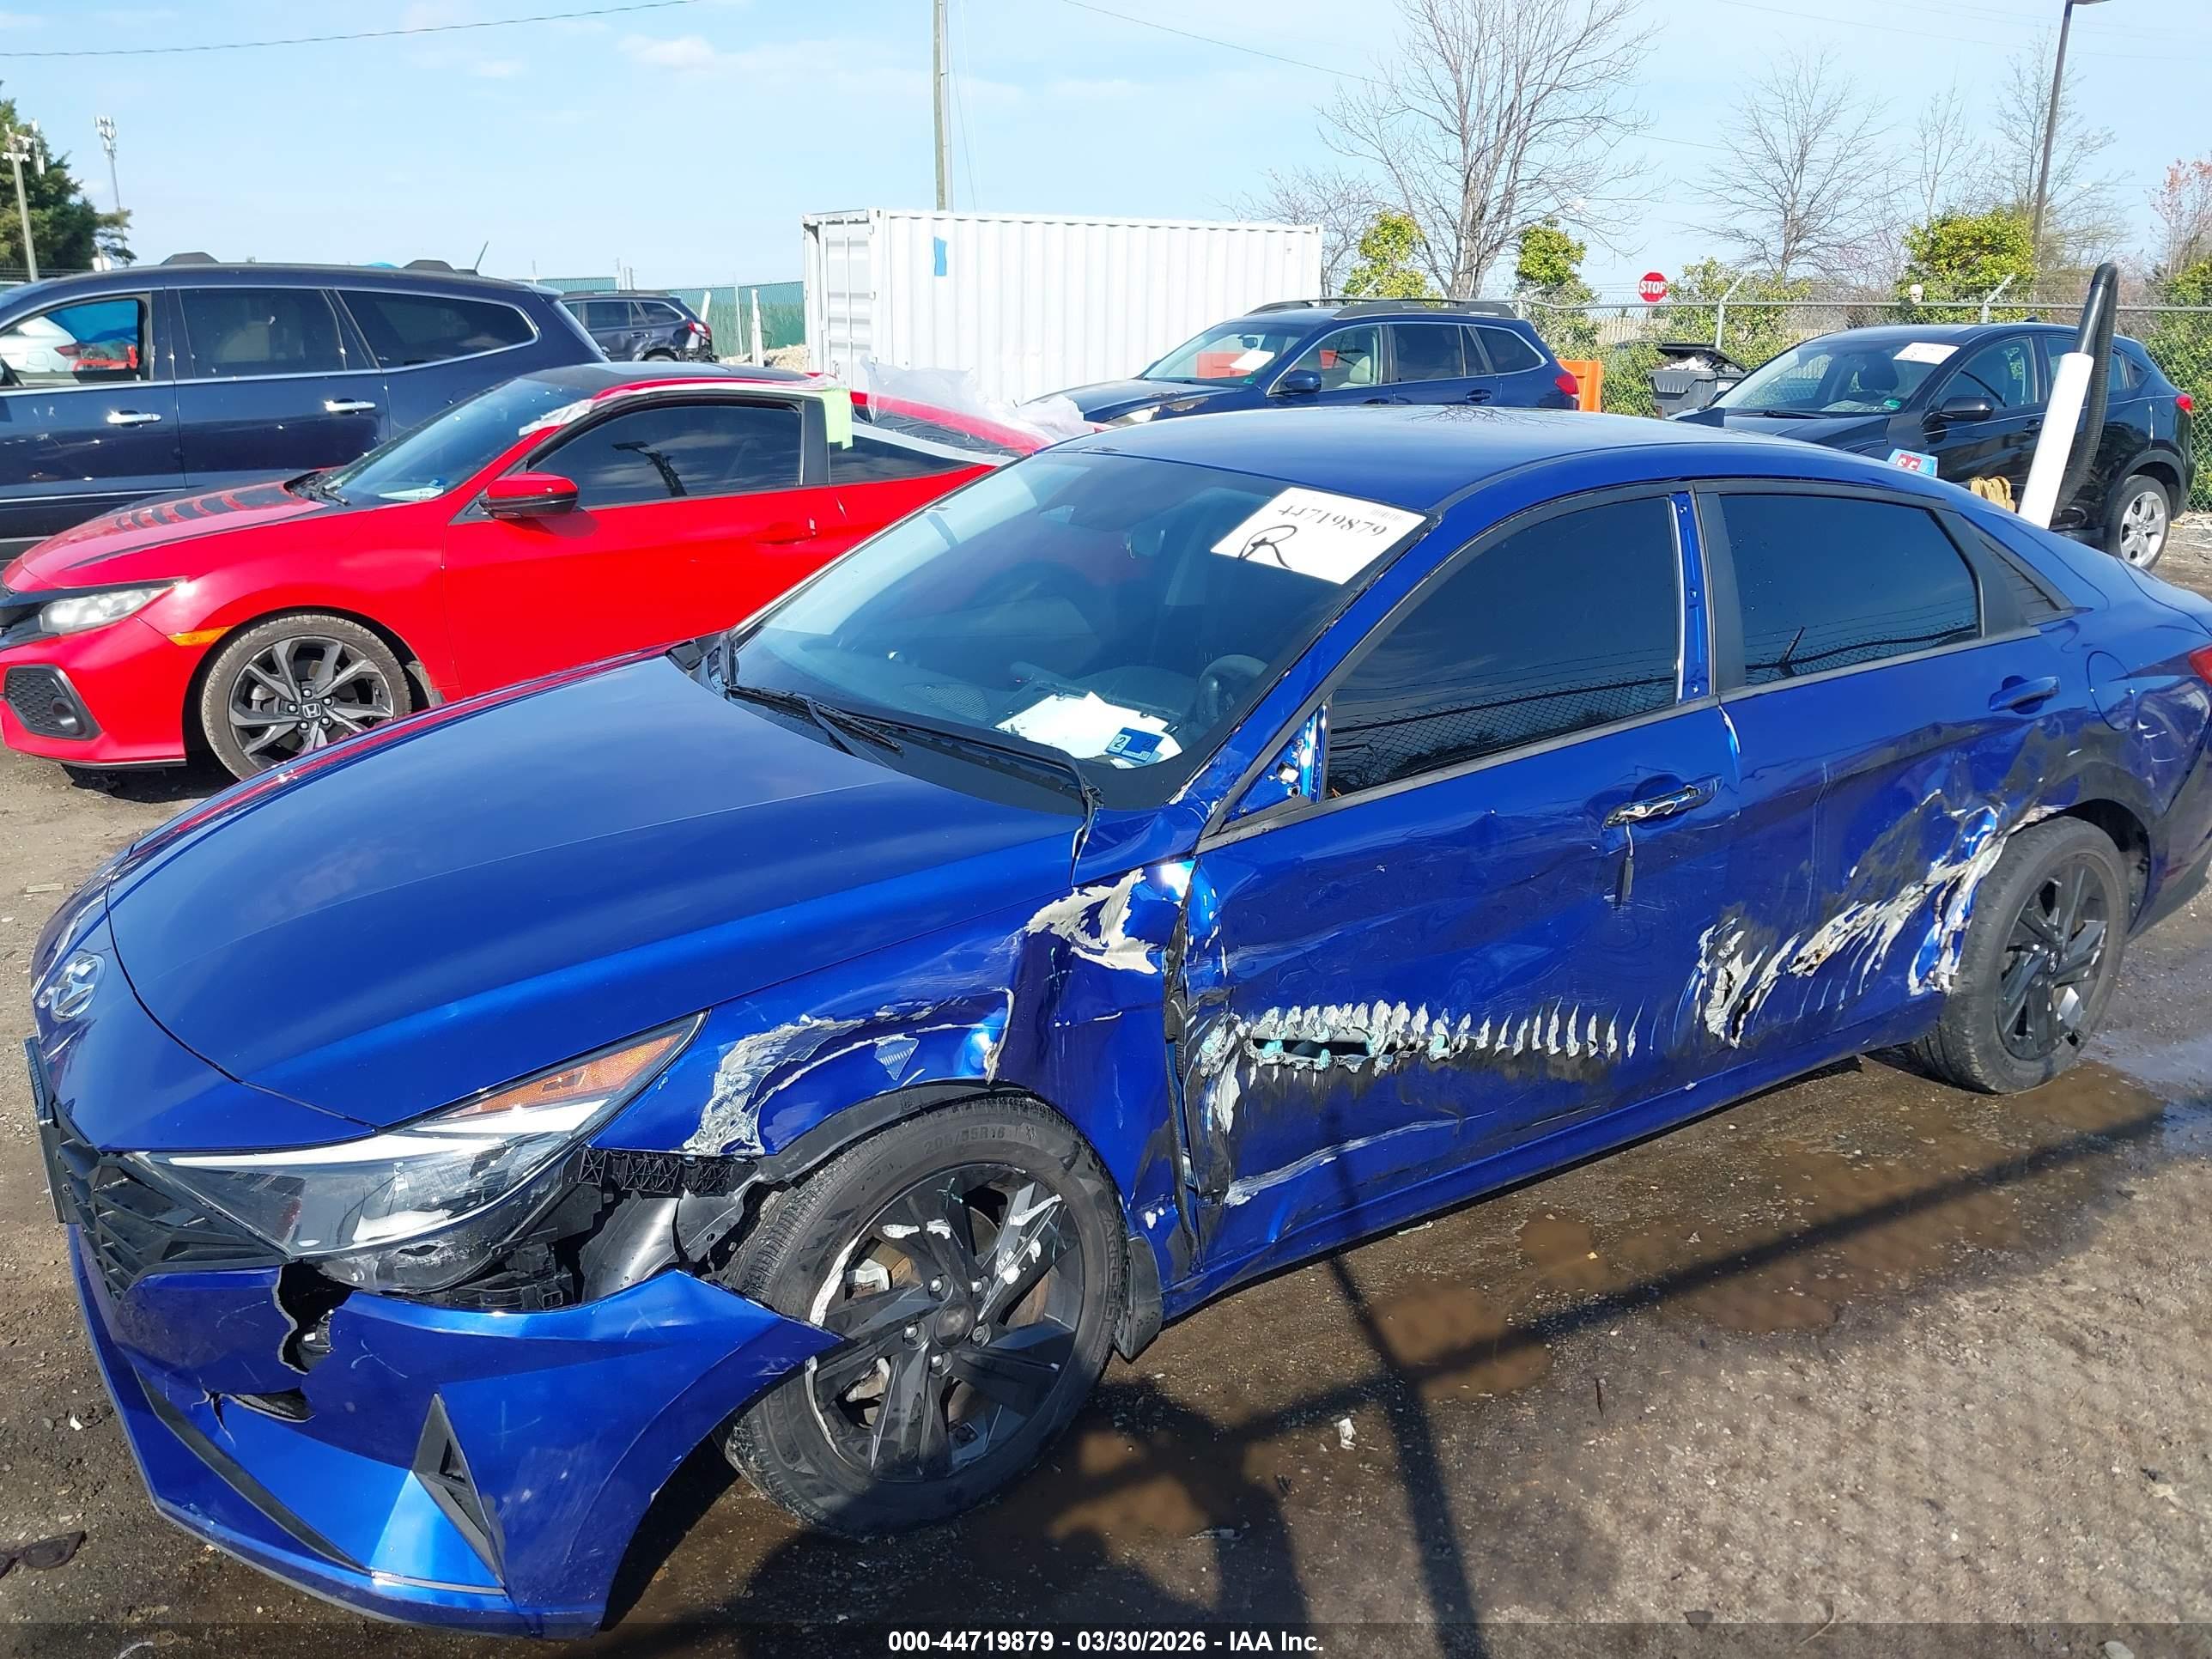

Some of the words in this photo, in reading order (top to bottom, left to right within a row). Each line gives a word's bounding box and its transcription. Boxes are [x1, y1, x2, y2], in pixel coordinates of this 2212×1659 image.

[1639, 280, 1668, 295] STOP
[1279, 505, 1388, 537] 44719879
[1237, 524, 1298, 569] R
